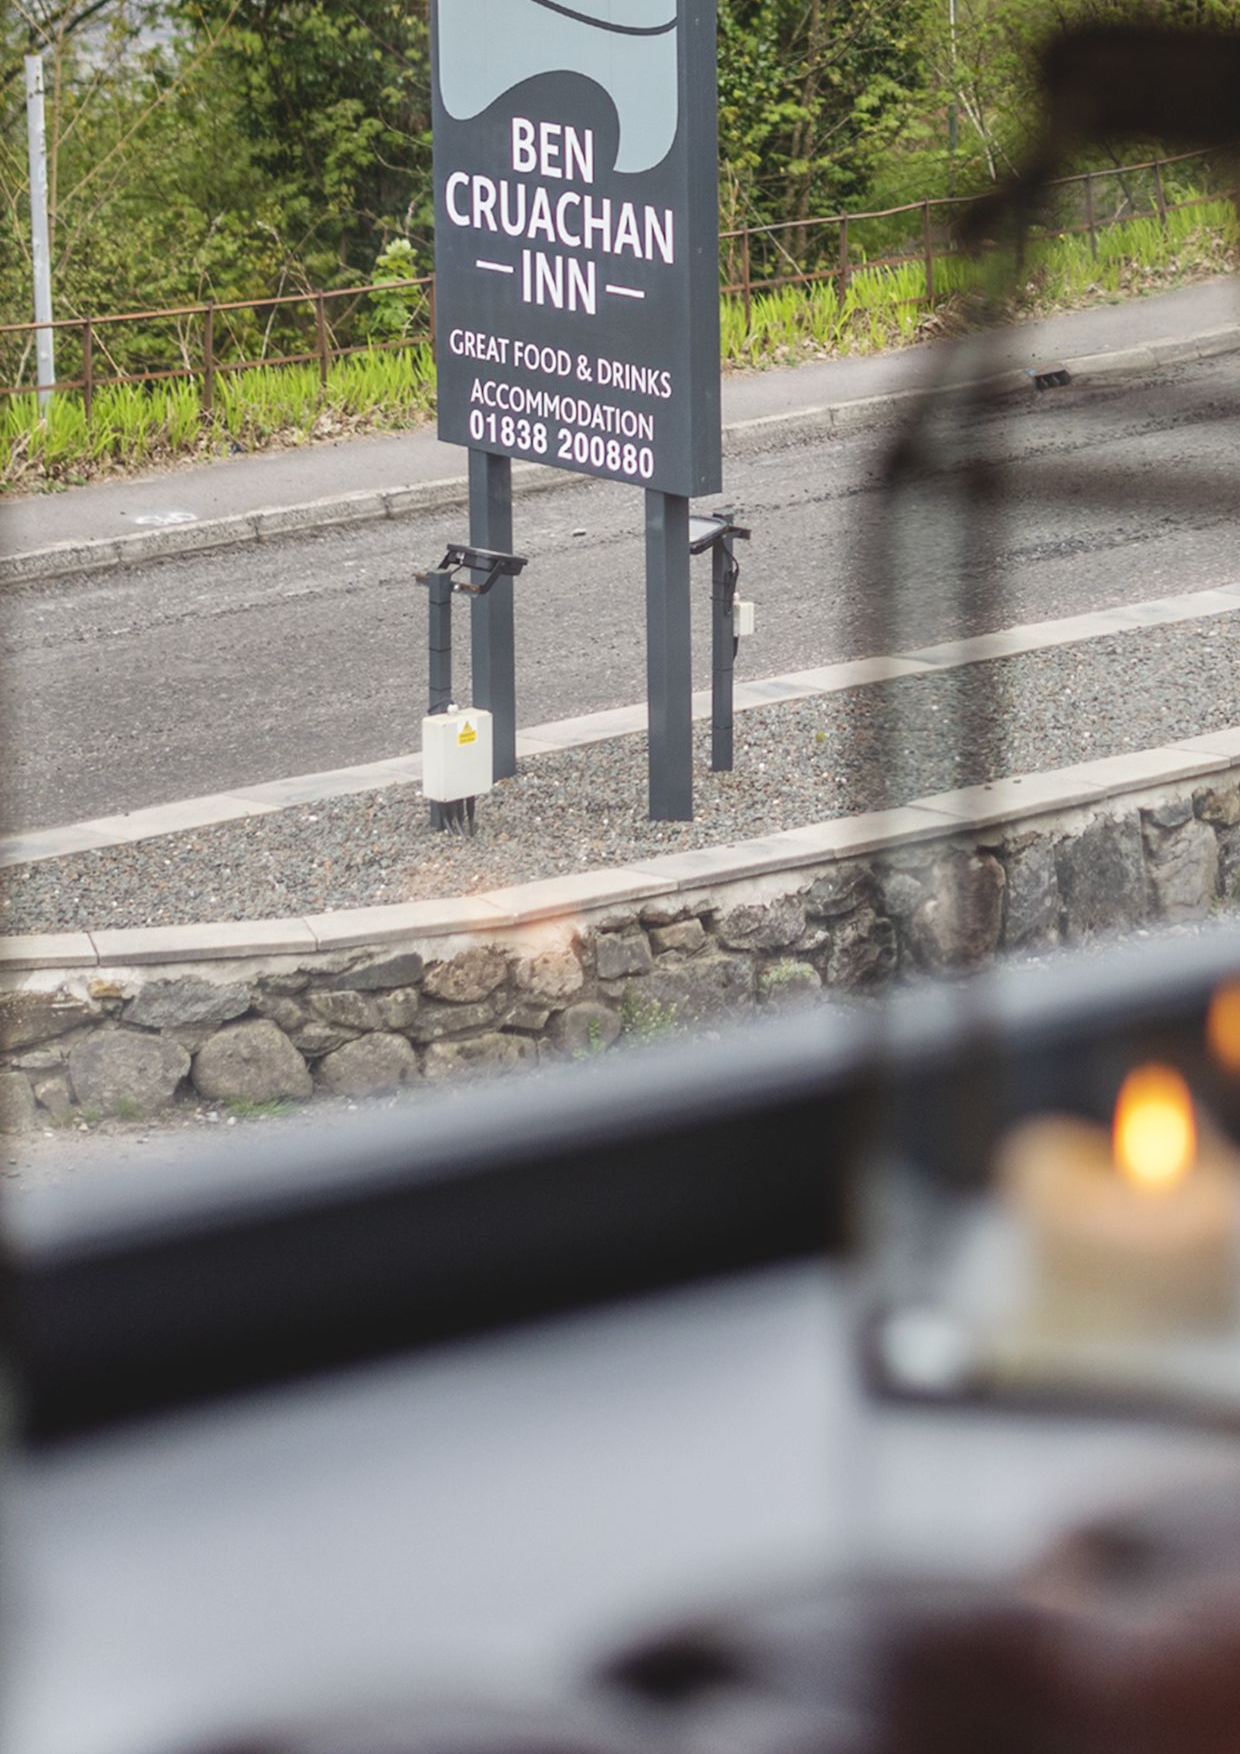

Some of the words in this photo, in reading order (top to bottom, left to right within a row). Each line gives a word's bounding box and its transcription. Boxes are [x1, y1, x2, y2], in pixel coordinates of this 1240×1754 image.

[512, 117, 593, 183] BEN
[445, 171, 674, 264] CRUACHAN
[522, 249, 596, 315] INN
[449, 328, 509, 364] GREAT
[514, 341, 572, 376] FOOD
[577, 355, 592, 381] &
[597, 359, 672, 398] DRINKS
[470, 378, 654, 441] ACCOMMODATION
[469, 409, 547, 453] 01838
[557, 428, 654, 479] 200880
